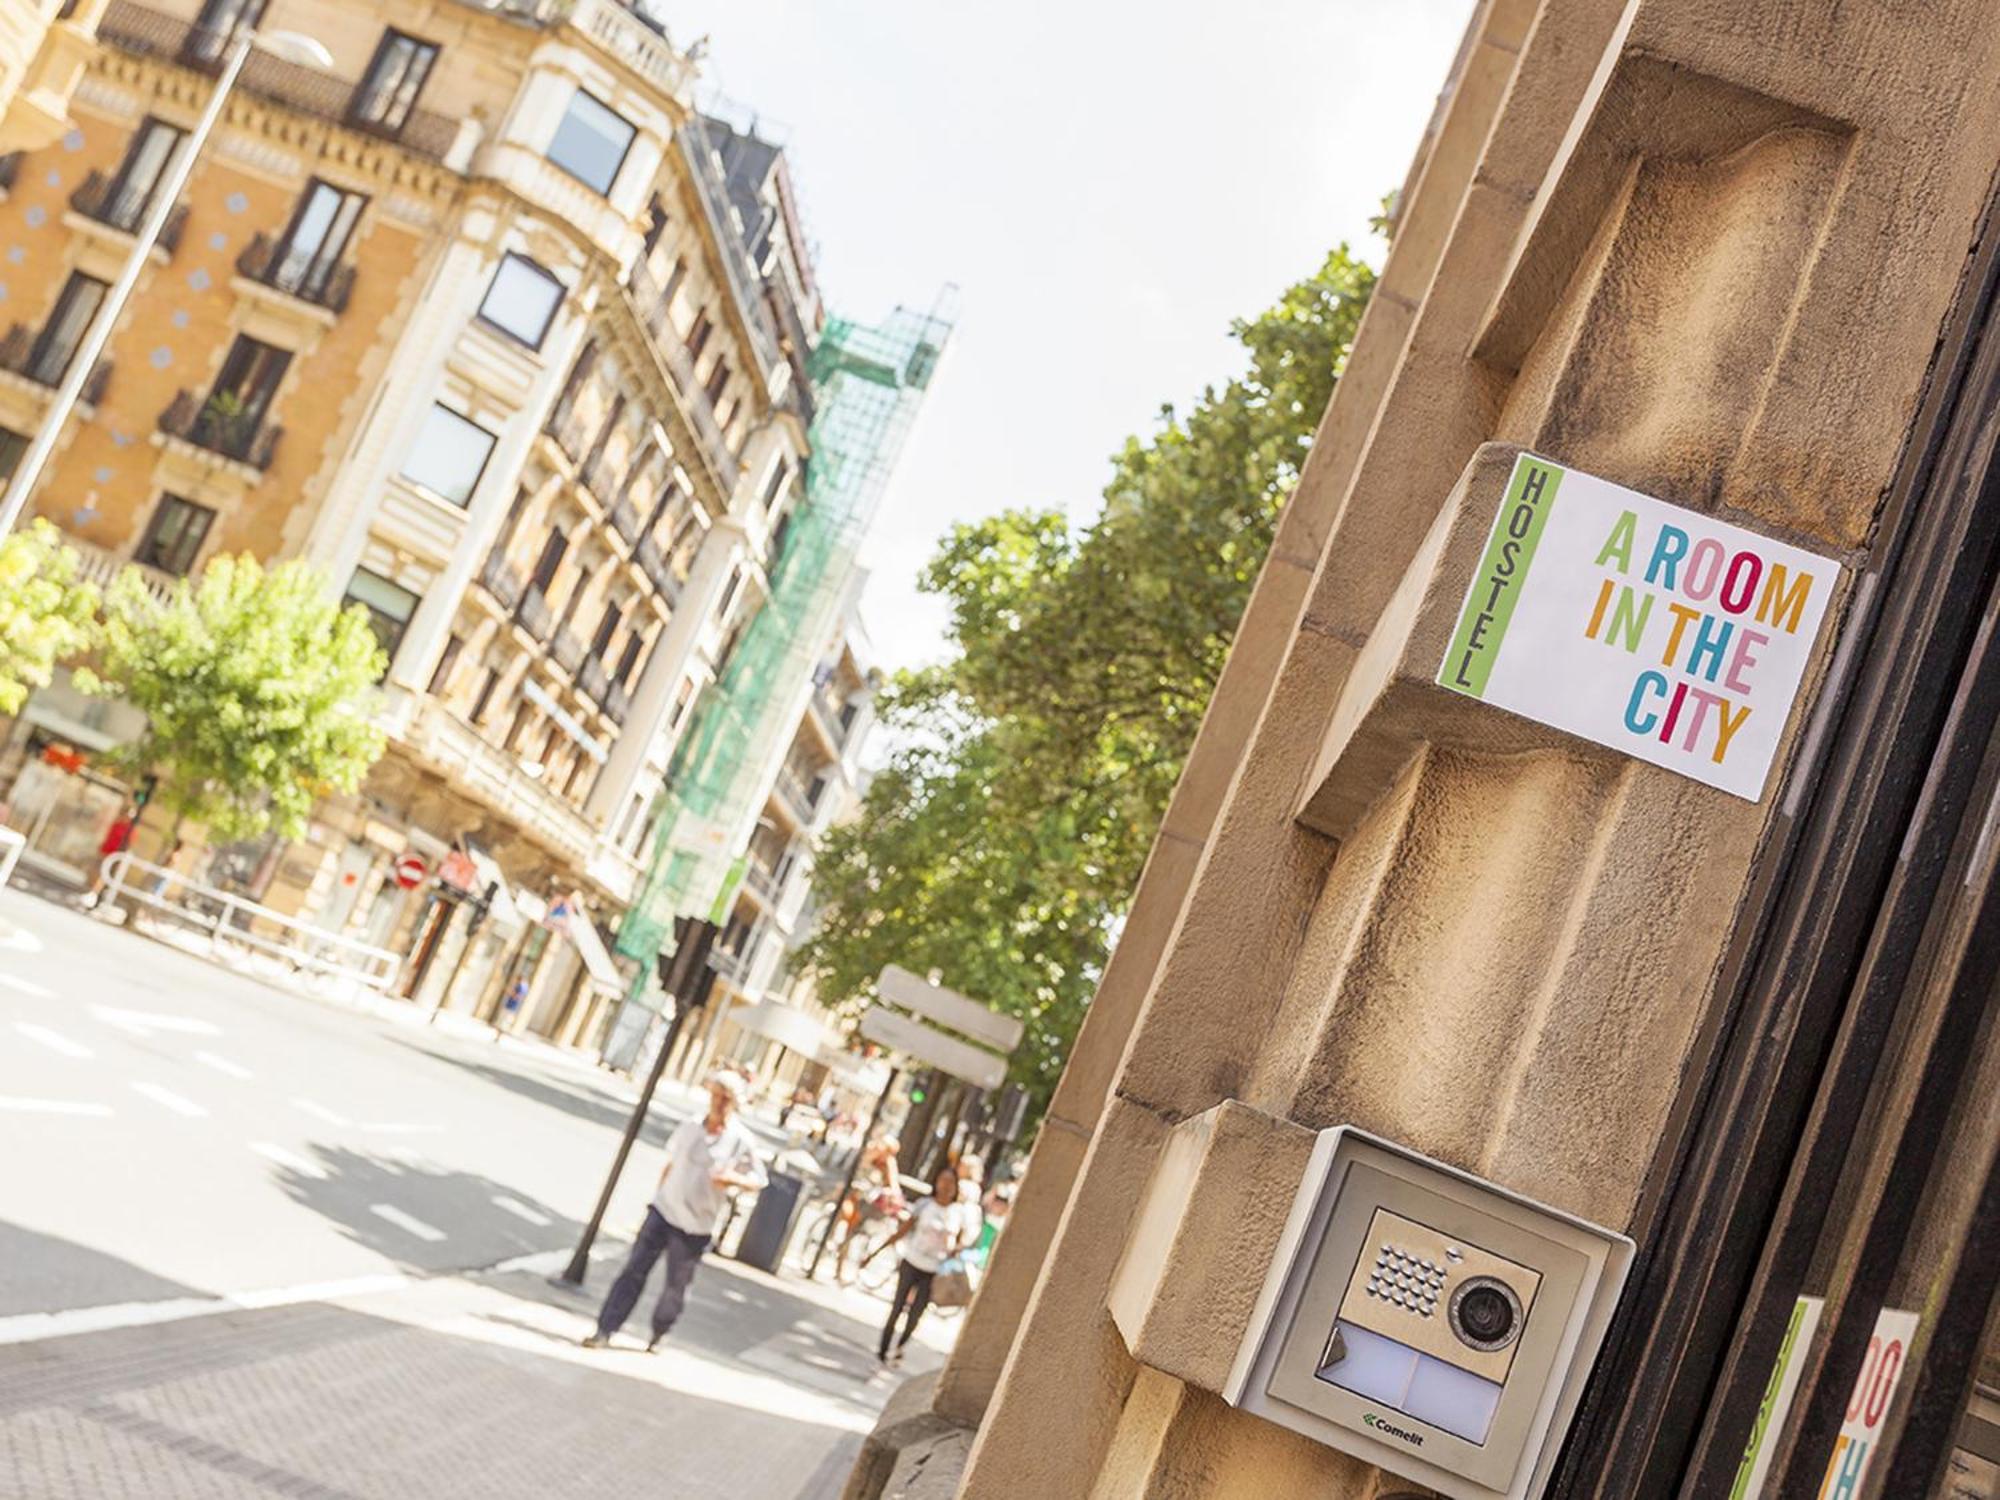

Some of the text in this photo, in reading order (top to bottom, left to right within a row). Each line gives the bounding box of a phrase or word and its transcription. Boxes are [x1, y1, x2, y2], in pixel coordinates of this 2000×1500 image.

[1455, 467, 1548, 688] HOSTEL
[1595, 510, 1814, 634] A ROOM
[1585, 579, 1769, 695] IN THE
[1624, 670, 1752, 764] CITY
[1375, 1418, 1424, 1446] Comelit
